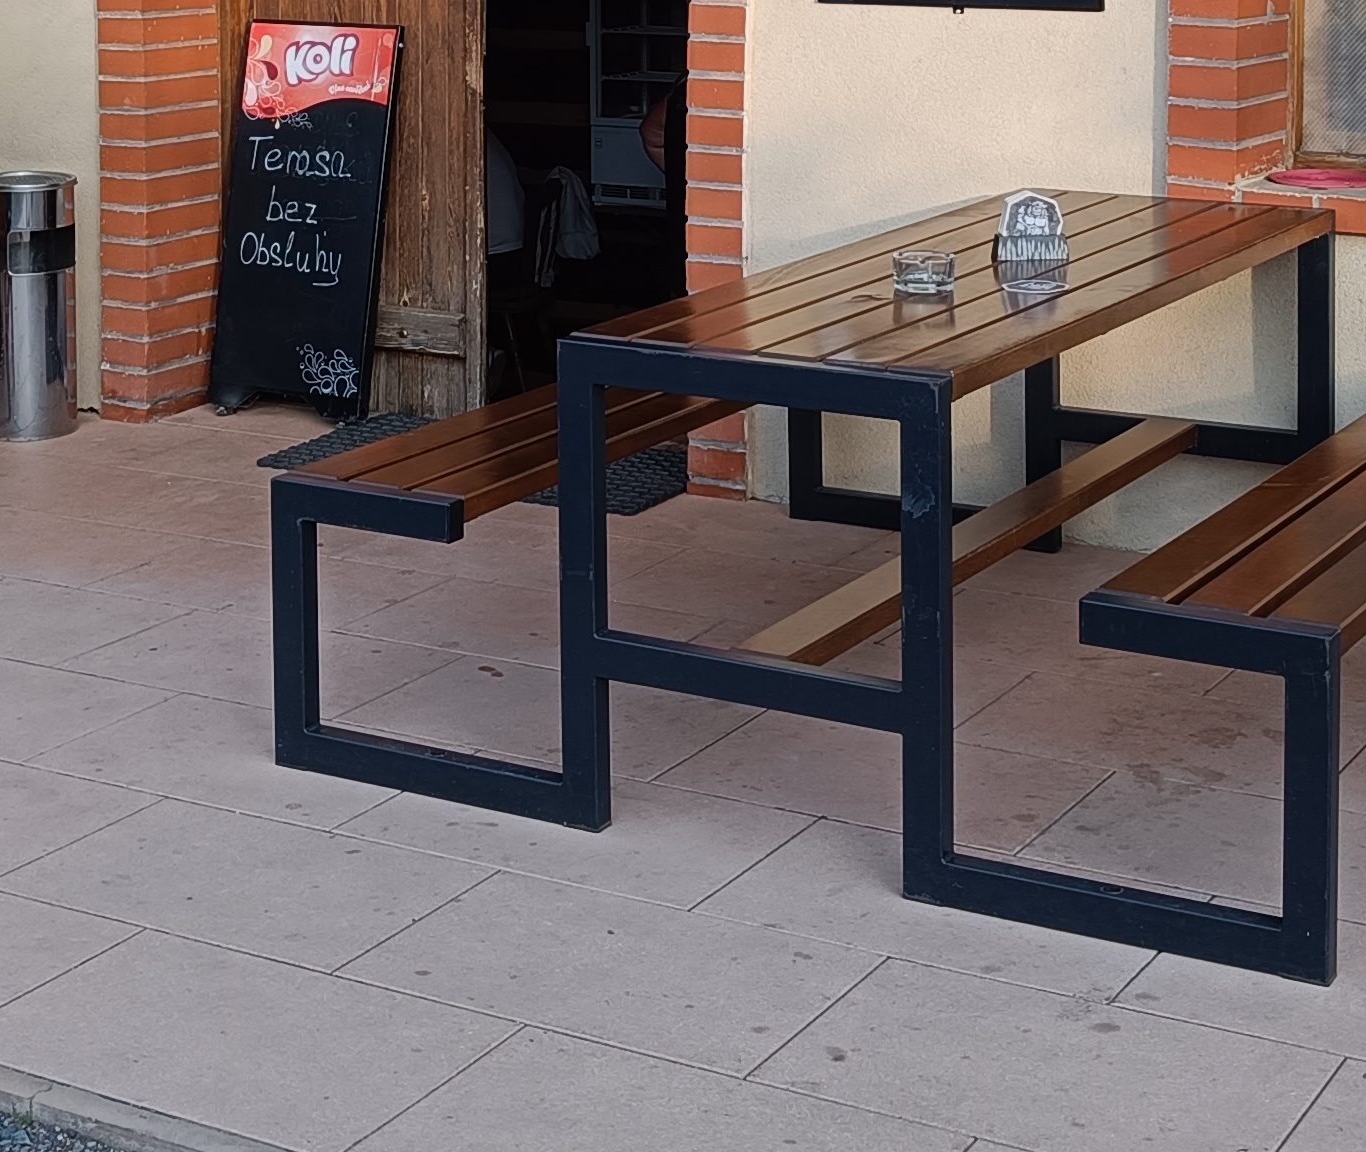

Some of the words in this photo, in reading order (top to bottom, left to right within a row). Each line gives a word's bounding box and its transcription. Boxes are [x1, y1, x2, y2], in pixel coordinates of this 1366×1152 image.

[285, 34, 357, 85] Koli
[248, 135, 352, 178] Terasa
[266, 185, 318, 224] bez
[239, 230, 342, 286] Obsluhy
